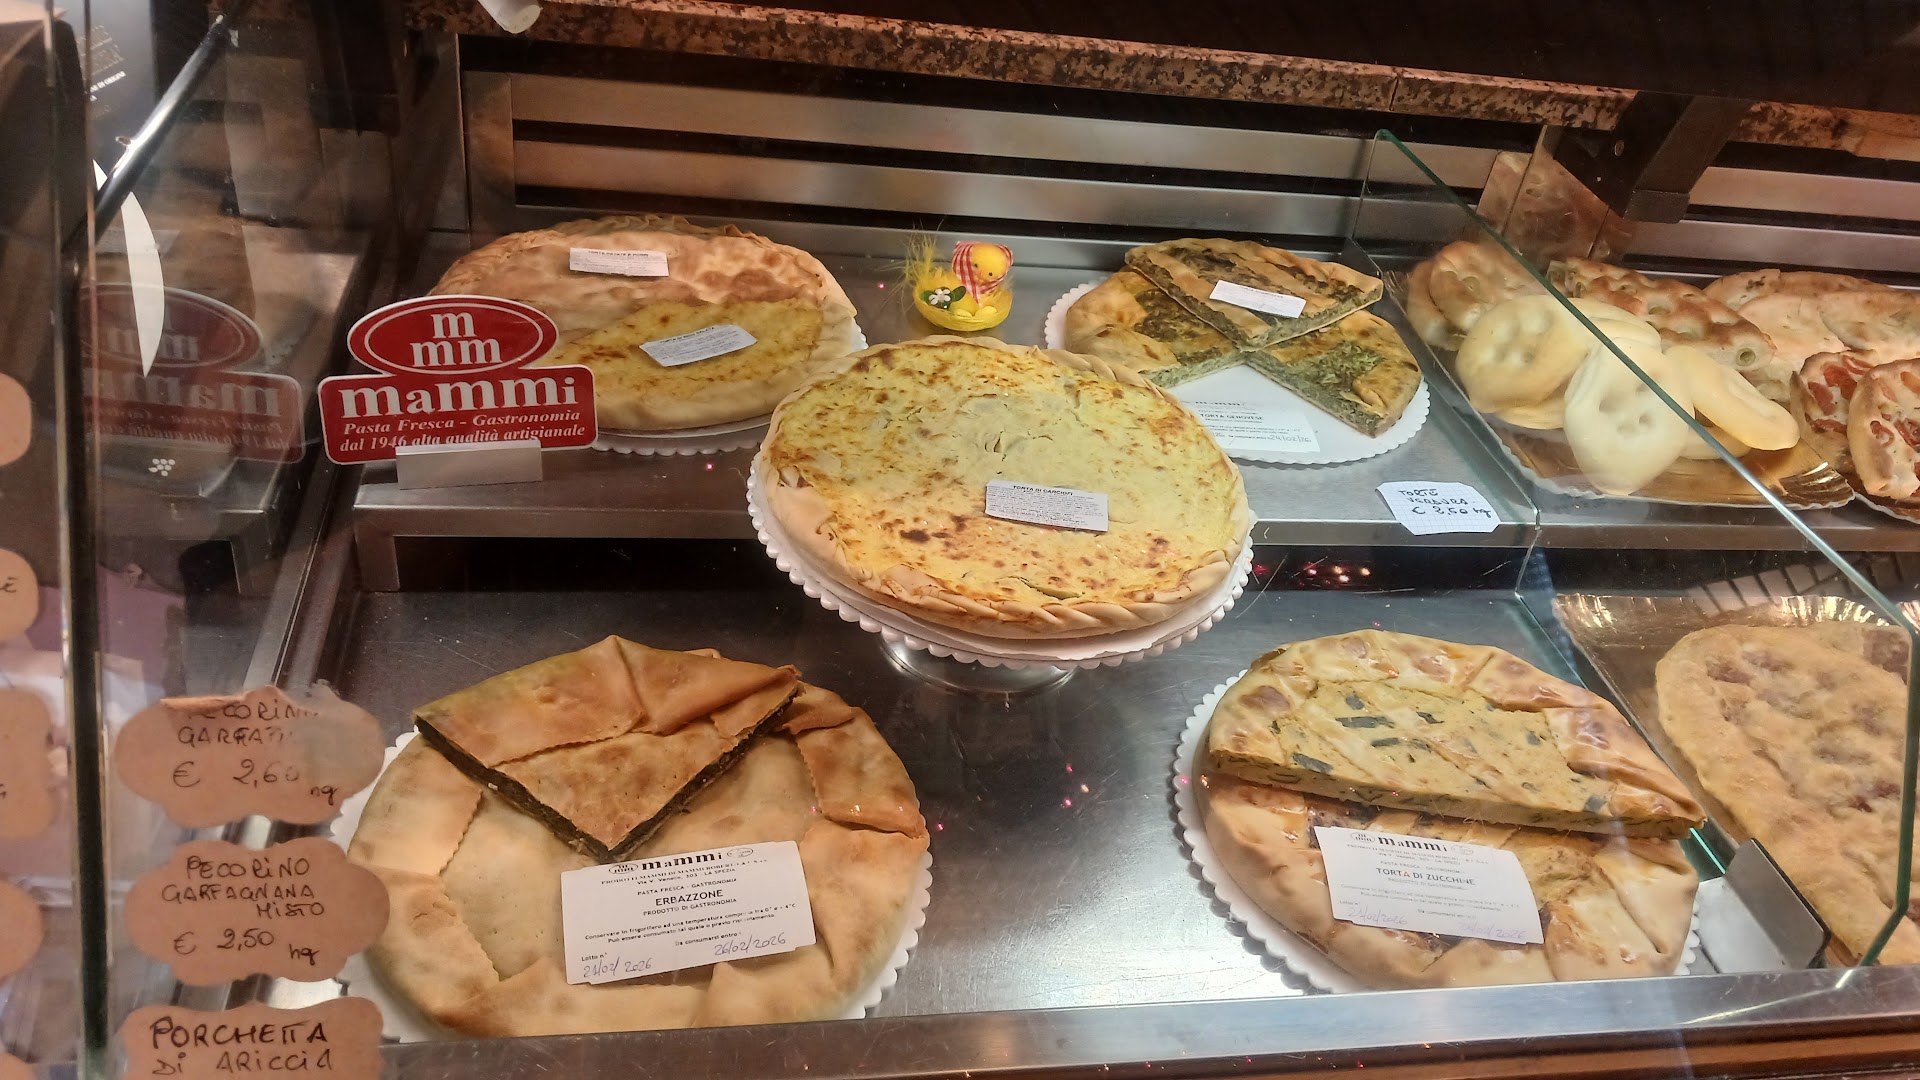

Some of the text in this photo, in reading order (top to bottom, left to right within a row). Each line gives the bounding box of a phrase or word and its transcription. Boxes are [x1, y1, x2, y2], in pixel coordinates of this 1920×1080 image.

[409, 337, 503, 368] mm
[337, 376, 580, 419] mammi
[343, 422, 391, 435] Pasta
[398, 418, 454, 432] Fresca
[472, 409, 580, 427] Gastronomia
[340, 424, 585, 452] dal 1946 alta qualità artigianale
[173, 761, 200, 788] €
[1378, 836, 1448, 852] mammi
[186, 854, 310, 881] PECORINO
[642, 852, 722, 871] mammi
[660, 885, 685, 893] FRESCA
[691, 877, 737, 889] GASTRONOMIA
[1375, 867, 1411, 878] TORTA
[1425, 873, 1476, 886] ZUCCHINE
[161, 883, 316, 905] GARFAGNANA
[655, 889, 724, 906] ERBAZZONE
[256, 901, 326, 920] MISTO
[643, 906, 680, 917] PRODOTTO
[690, 898, 737, 910] GASTRONOMIA
[584, 930, 620, 941] Conservare
[629, 923, 662, 934] frigorifero
[685, 914, 724, 926] temperatura
[643, 929, 677, 938] consumato
[687, 924, 705, 932] quale
[711, 920, 731, 929] previo
[173, 927, 320, 967] € 2,50 hg
[684, 935, 720, 945] consumarsi
[581, 954, 599, 962] Lotto
[149, 1015, 328, 1050] PORCHETTA
[216, 1048, 333, 1075] ARICCIA
